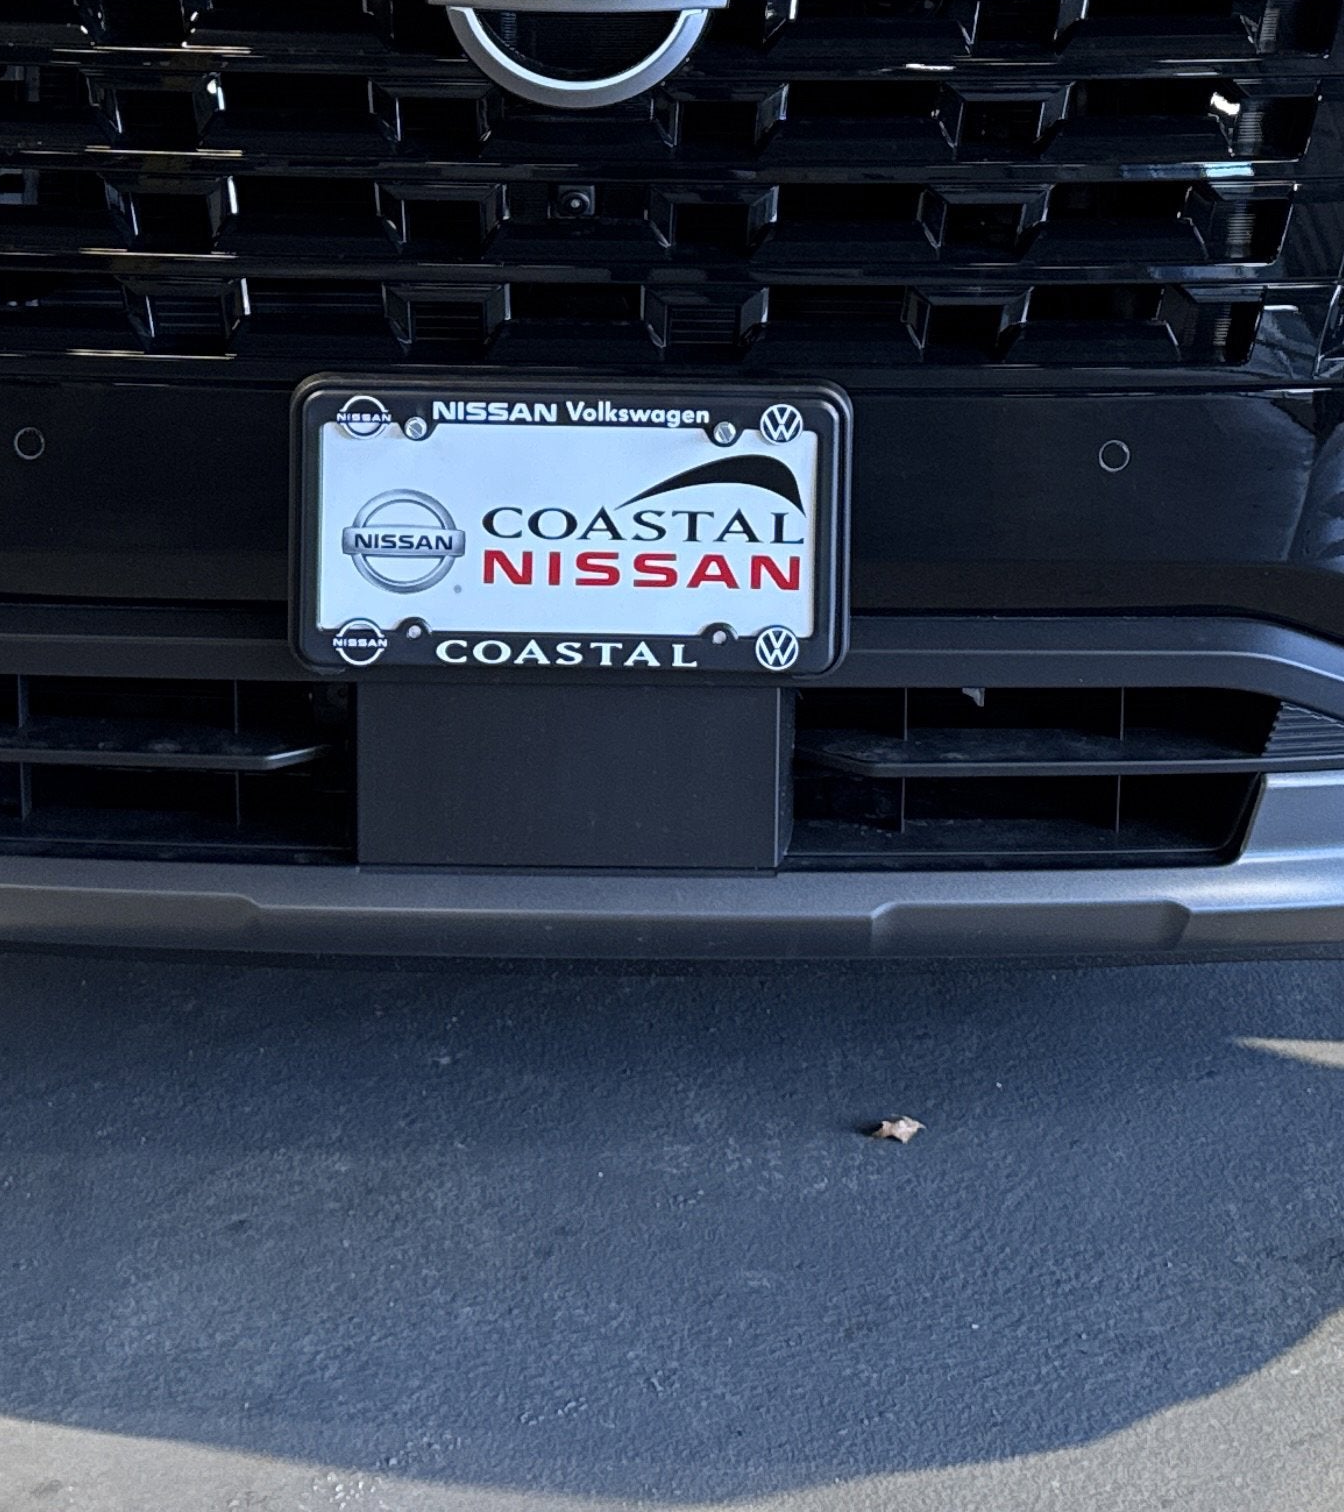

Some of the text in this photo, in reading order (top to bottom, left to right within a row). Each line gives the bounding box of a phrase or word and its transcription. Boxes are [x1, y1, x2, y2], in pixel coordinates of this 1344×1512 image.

[337, 412, 392, 422] NISSAN
[432, 401, 710, 428] NISSAN Volkswagen
[482, 506, 805, 543] COASTAL
[354, 533, 454, 551] NISSAN
[483, 550, 800, 590] NISSAN
[333, 637, 388, 648] NISSAN
[436, 640, 698, 667] COASTAL
